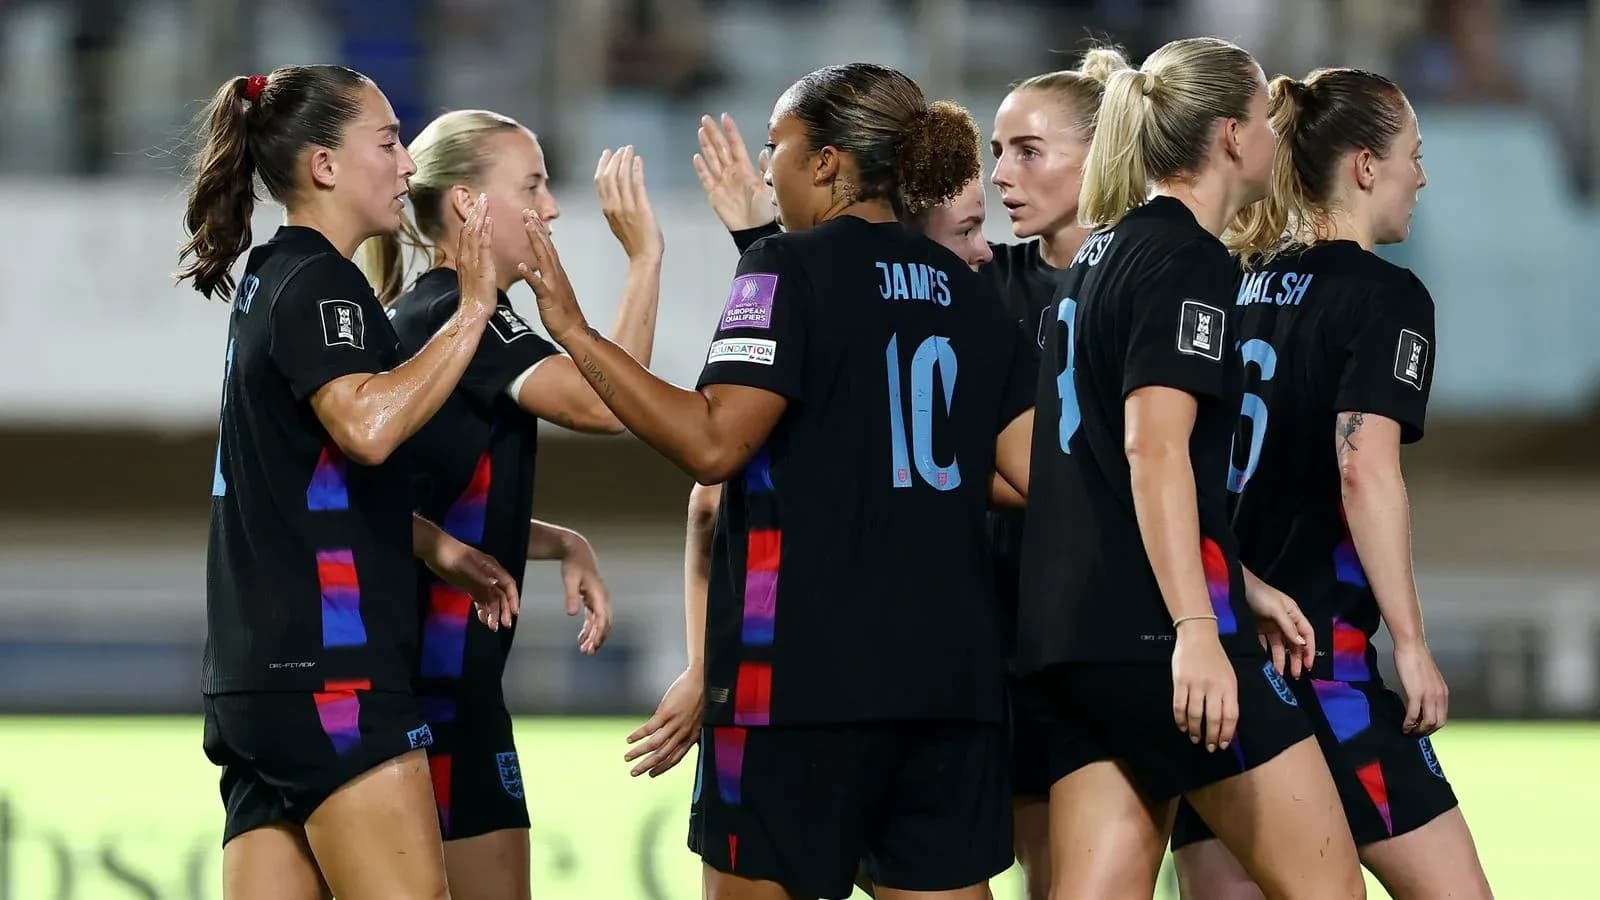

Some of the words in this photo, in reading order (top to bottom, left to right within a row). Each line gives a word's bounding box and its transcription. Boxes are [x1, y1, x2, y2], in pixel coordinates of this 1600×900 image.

[875, 261, 951, 307] JAMES
[1236, 271, 1314, 306] WALSH
[725, 314, 766, 323] QUALIFIERS
[727, 307, 766, 316] EUROPEAN
[886, 332, 961, 491] 10
